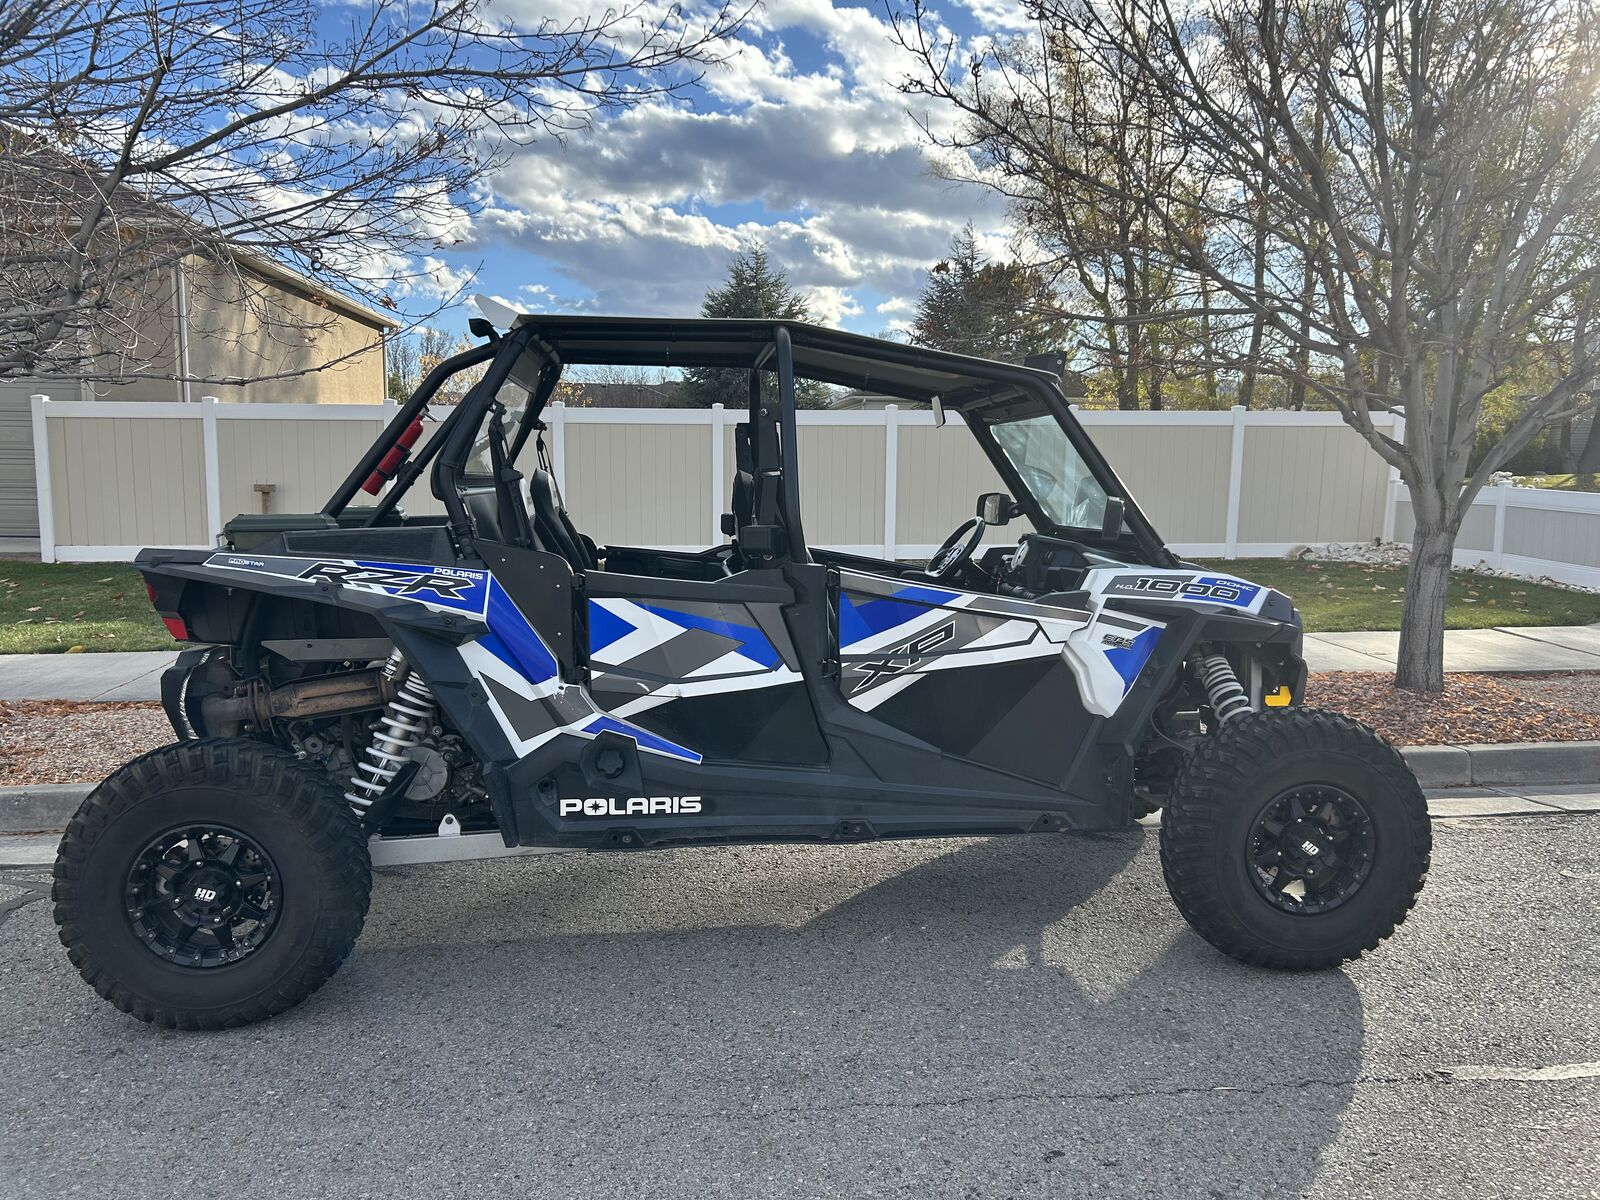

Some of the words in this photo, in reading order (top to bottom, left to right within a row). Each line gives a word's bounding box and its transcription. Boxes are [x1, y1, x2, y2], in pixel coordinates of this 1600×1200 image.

[297, 561, 476, 600] RZR
[433, 567, 484, 580] POLARIS
[1134, 577, 1240, 601] 1000
[850, 620, 956, 694] XP
[559, 796, 702, 817] POLARIS
[1301, 840, 1319, 855] HD
[194, 887, 216, 900] HD
